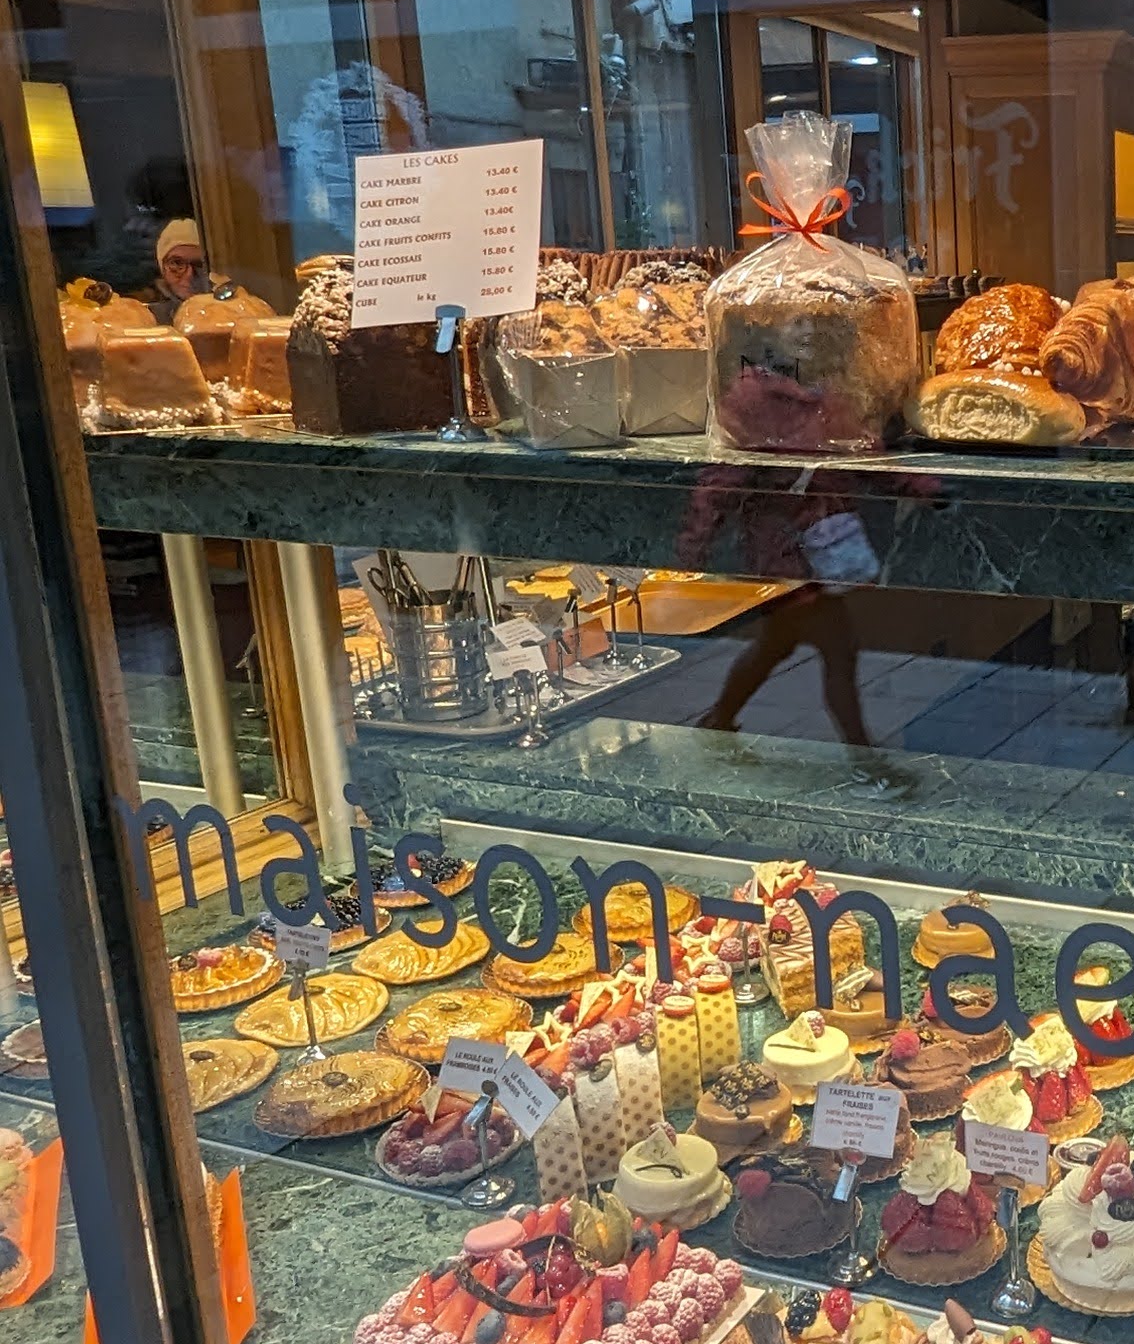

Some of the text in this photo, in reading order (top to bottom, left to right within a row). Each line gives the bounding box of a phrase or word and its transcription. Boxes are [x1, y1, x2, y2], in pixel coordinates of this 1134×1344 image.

[403, 153, 459, 169] LES CAKES
[360, 179, 383, 189] CAKE
[512, 166, 519, 174] €
[360, 199, 383, 209] CAKE
[385, 196, 420, 207] CITRON
[511, 186, 518, 194] €
[359, 219, 382, 229] CAKE
[384, 216, 421, 227] ORANGE
[358, 239, 381, 249] CAKE
[384, 235, 413, 246] FRUITS
[415, 232, 452, 243] CONFITS
[358, 259, 380, 268] CAKE
[382, 254, 422, 266] ECOSSAIS
[508, 246, 515, 254] €
[356, 278, 379, 288] CAKE
[381, 274, 427, 285] EQUATEUR
[507, 266, 514, 274] €
[355, 298, 377, 308] CUBE
[425, 292, 436, 302] kg
[507, 286, 513, 294] €
[828, 1087, 876, 1101] TARTELETTE
